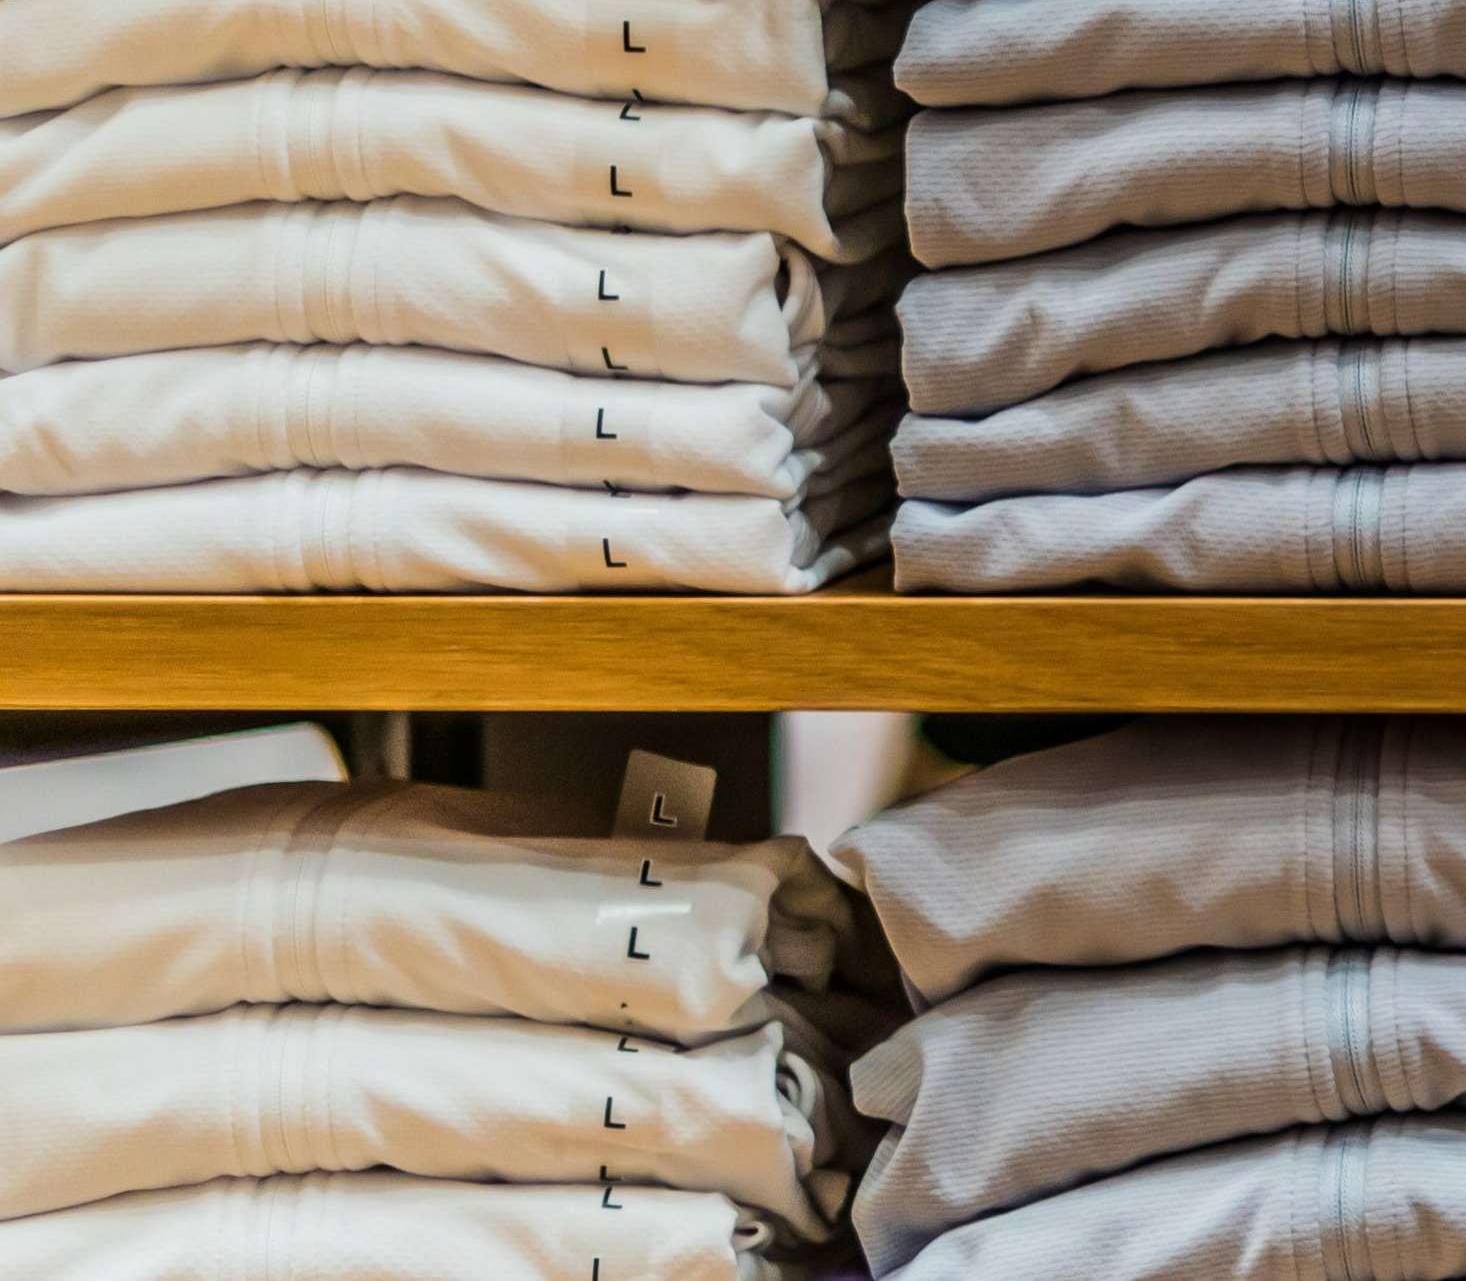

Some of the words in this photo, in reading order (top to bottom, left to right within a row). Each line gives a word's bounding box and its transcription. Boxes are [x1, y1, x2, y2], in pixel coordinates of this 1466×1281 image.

[624, 21, 645, 52] L
[620, 102, 640, 120] L
[611, 166, 632, 196] L
[598, 270, 619, 300] L
[602, 347, 628, 369] L
[596, 408, 617, 438] L
[603, 538, 627, 567] L
[650, 793, 677, 826] L
[640, 860, 662, 887] L
[628, 927, 650, 959] L
[605, 1097, 626, 1128] L
[602, 1187, 622, 1208] L
